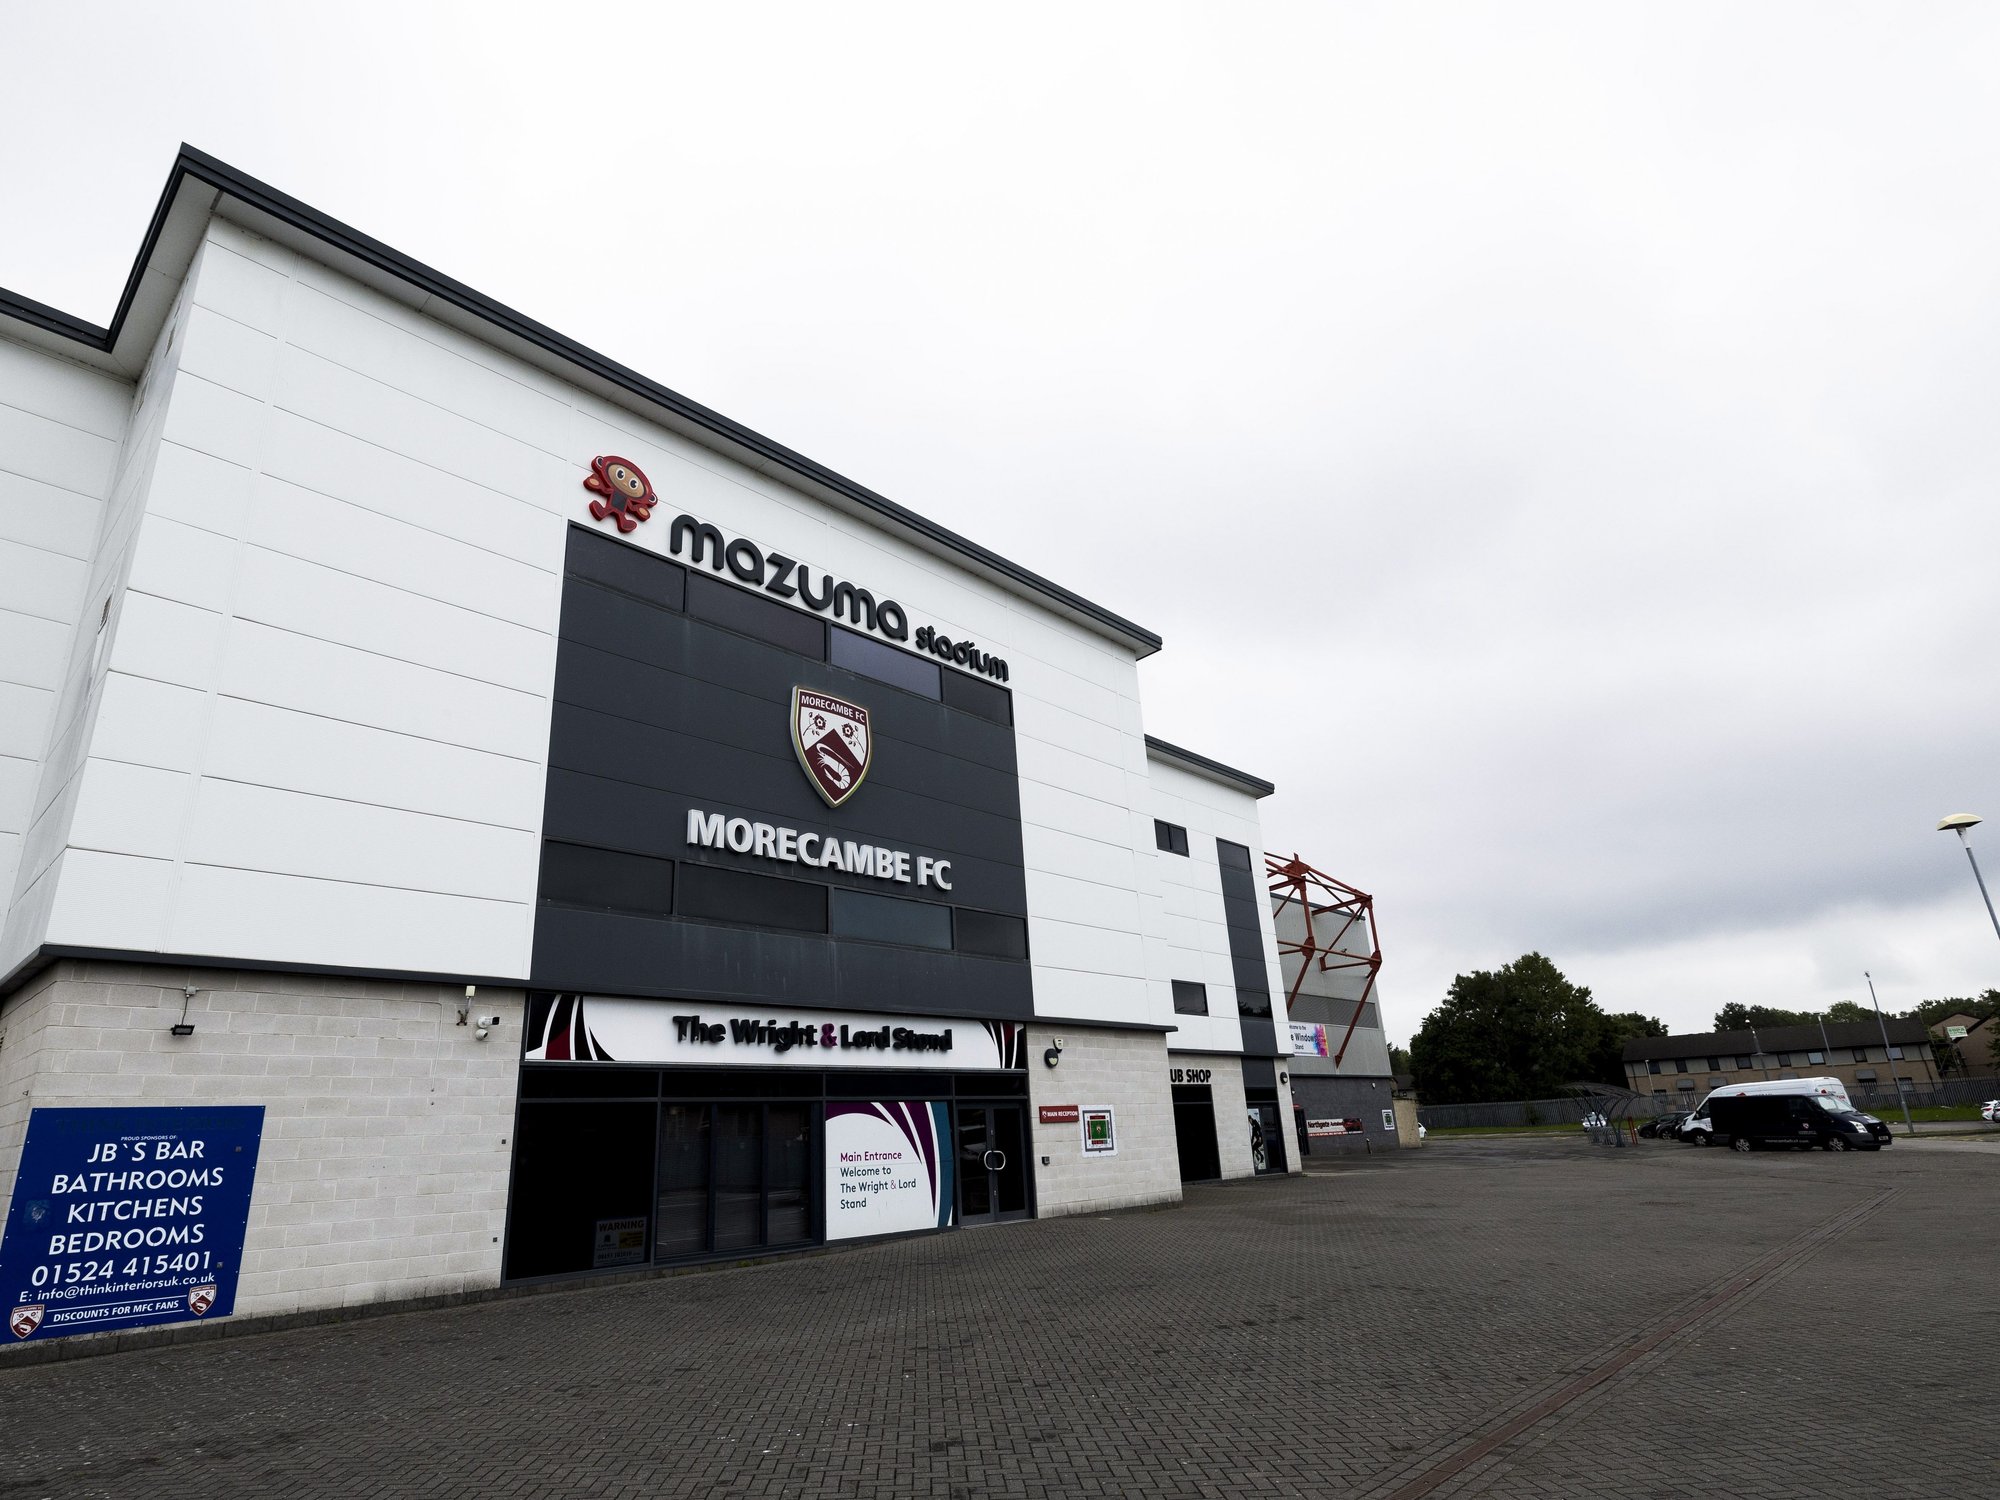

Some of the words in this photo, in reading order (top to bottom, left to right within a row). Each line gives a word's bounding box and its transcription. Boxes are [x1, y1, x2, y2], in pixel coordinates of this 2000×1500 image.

[670, 514, 909, 641] mazuma
[915, 625, 1009, 682] stadium
[801, 695, 853, 717] MORECAMBE
[856, 711, 865, 723] FC
[687, 809, 911, 883] MORECAMBE
[917, 856, 952, 890] FC
[672, 1015, 726, 1043] The
[729, 1018, 818, 1051] Wright
[821, 1023, 838, 1048] &
[840, 1024, 890, 1050] Lord
[892, 1027, 953, 1051] Stand
[1186, 1069, 1211, 1083] SHOP
[155, 1140, 205, 1160] BAR
[840, 1151, 862, 1162] Main
[864, 1151, 902, 1161] Entrance
[51, 1167, 224, 1194] BATHROOMS
[840, 1166, 880, 1177] Welcome
[882, 1166, 891, 1175] to
[840, 1182, 856, 1193] The
[858, 1181, 888, 1194] Wright
[890, 1179, 896, 1190] &
[899, 1178, 916, 1189] Lord
[66, 1195, 204, 1224] KITCHENS
[840, 1197, 867, 1209] Stand
[48, 1223, 205, 1256] BEDROOMS
[599, 1220, 644, 1232] WARNING
[31, 1260, 114, 1287] 01524
[122, 1250, 211, 1277] 415401
[19, 1290, 33, 1303] E:
[37, 1272, 215, 1301] info@thinkinteriorsuk.co.uk
[53, 1308, 110, 1323] DISCOUNTS
[112, 1306, 131, 1316] FOR
[132, 1303, 153, 1313] MFC
[155, 1300, 179, 1311] FANS
